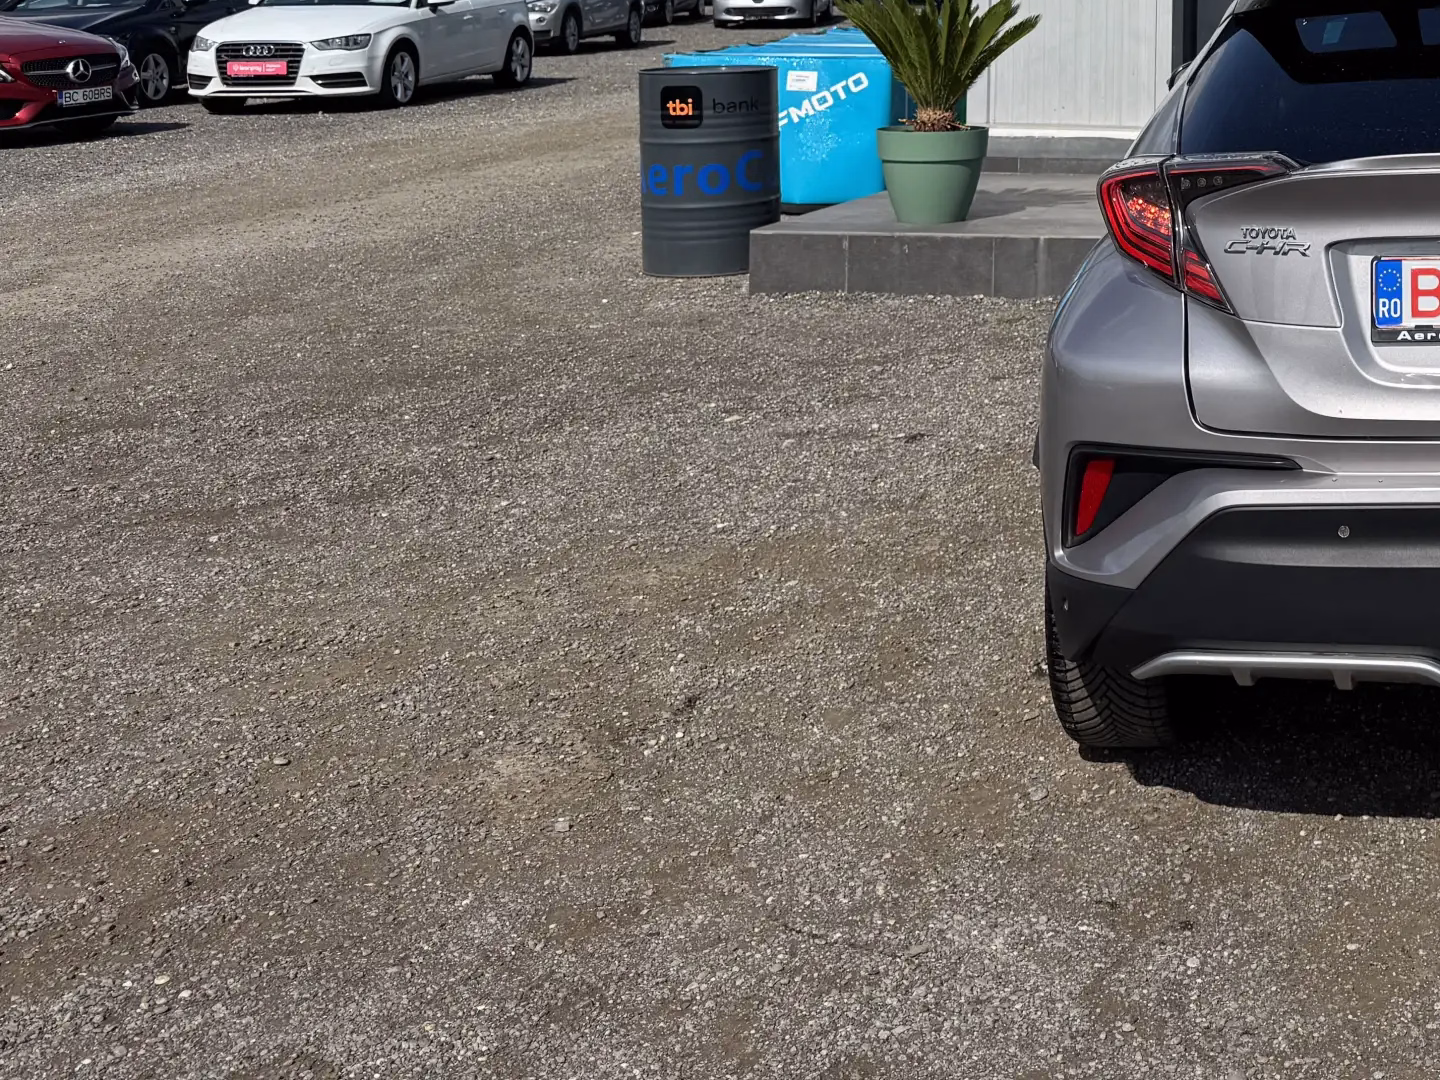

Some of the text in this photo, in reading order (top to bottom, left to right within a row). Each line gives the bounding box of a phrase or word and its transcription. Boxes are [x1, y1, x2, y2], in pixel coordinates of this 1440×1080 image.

[64, 87, 112, 103] BC 60BRS
[666, 98, 759, 116] tbi bank
[1240, 226, 1297, 241] TOYOTA
[1223, 240, 1311, 257] C-HR
[1379, 297, 1401, 318] RO
